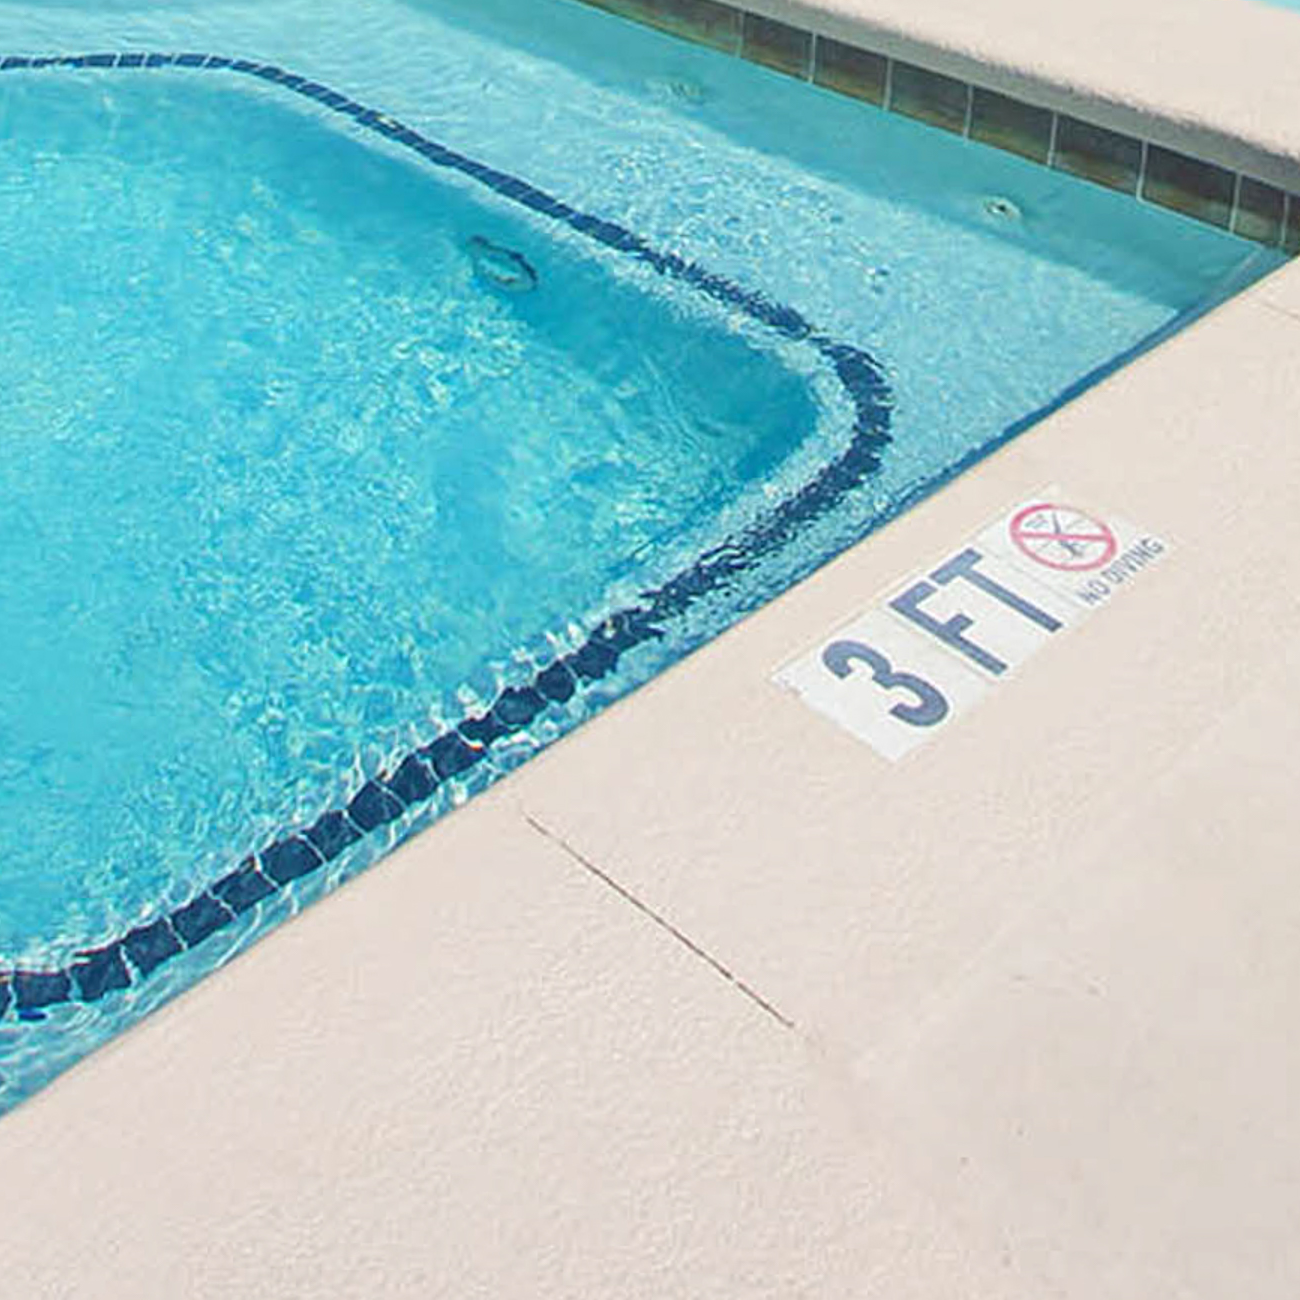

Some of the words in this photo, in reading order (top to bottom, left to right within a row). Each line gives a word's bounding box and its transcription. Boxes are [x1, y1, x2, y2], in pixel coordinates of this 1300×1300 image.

[1076, 568, 1111, 605] NO
[1099, 535, 1165, 586] DIVING
[821, 639, 950, 728] 3
[888, 547, 1063, 676] FT
